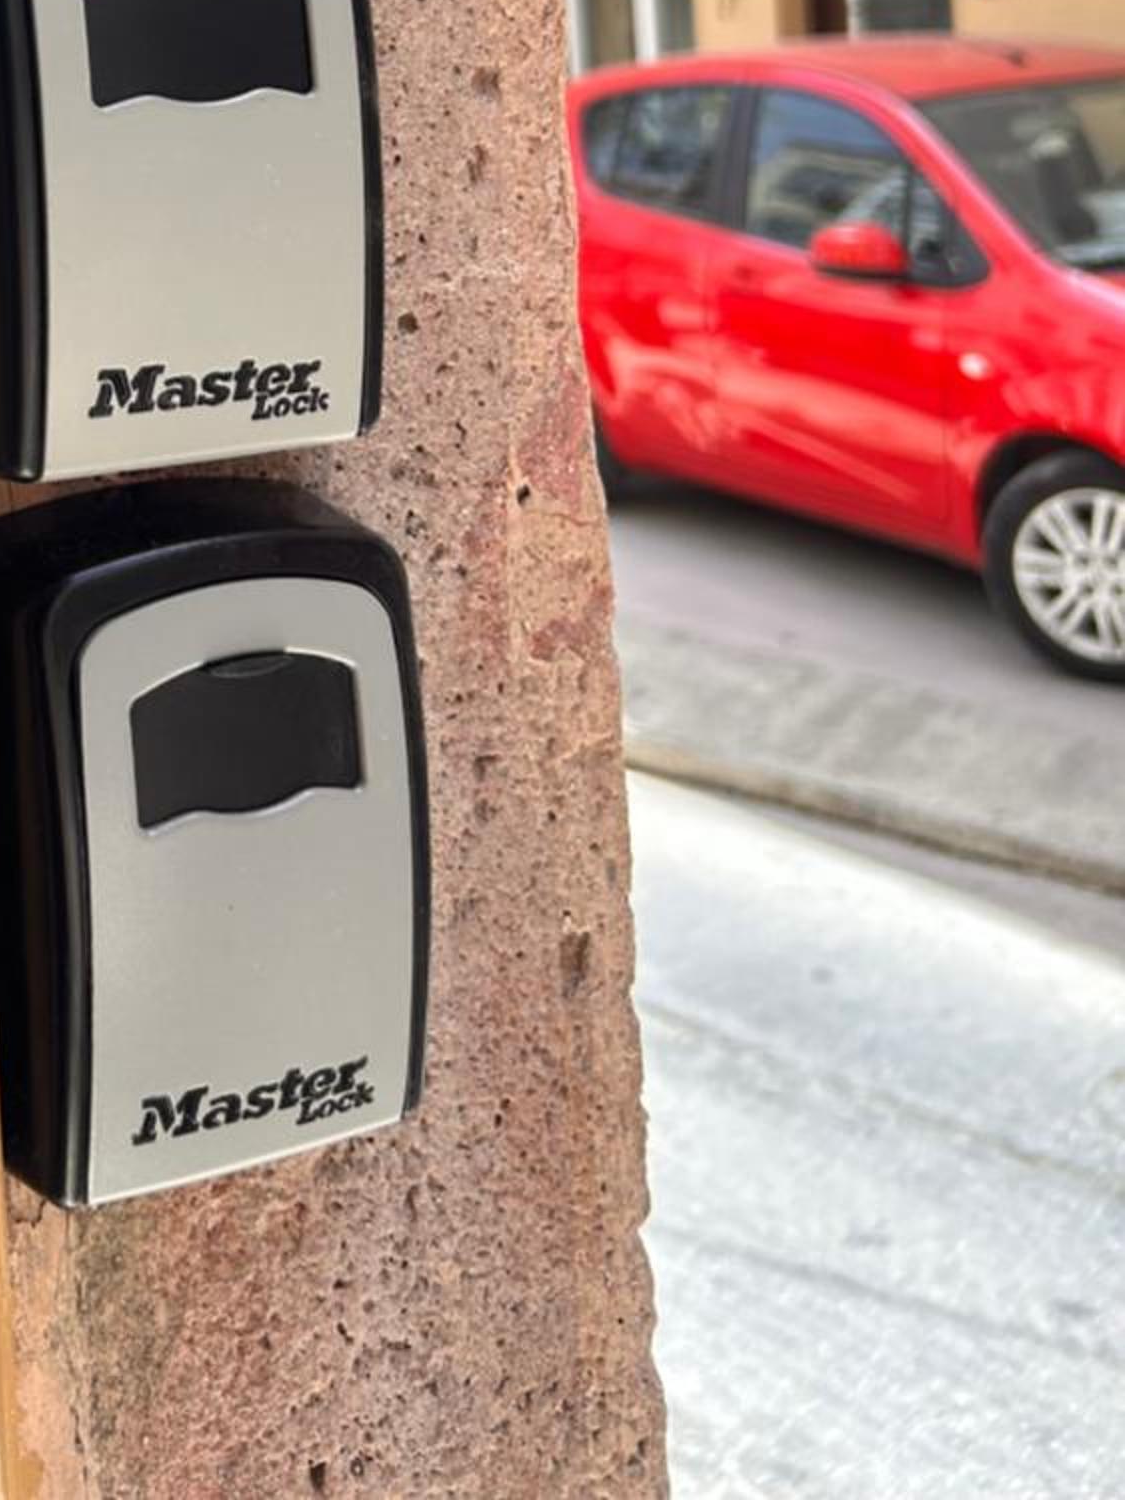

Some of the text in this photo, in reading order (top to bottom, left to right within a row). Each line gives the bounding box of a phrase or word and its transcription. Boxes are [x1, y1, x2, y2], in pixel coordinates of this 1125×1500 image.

[88, 359, 321, 418] Master
[251, 387, 329, 420] Lock
[132, 1055, 368, 1146] Master
[296, 1081, 375, 1125] Lock
